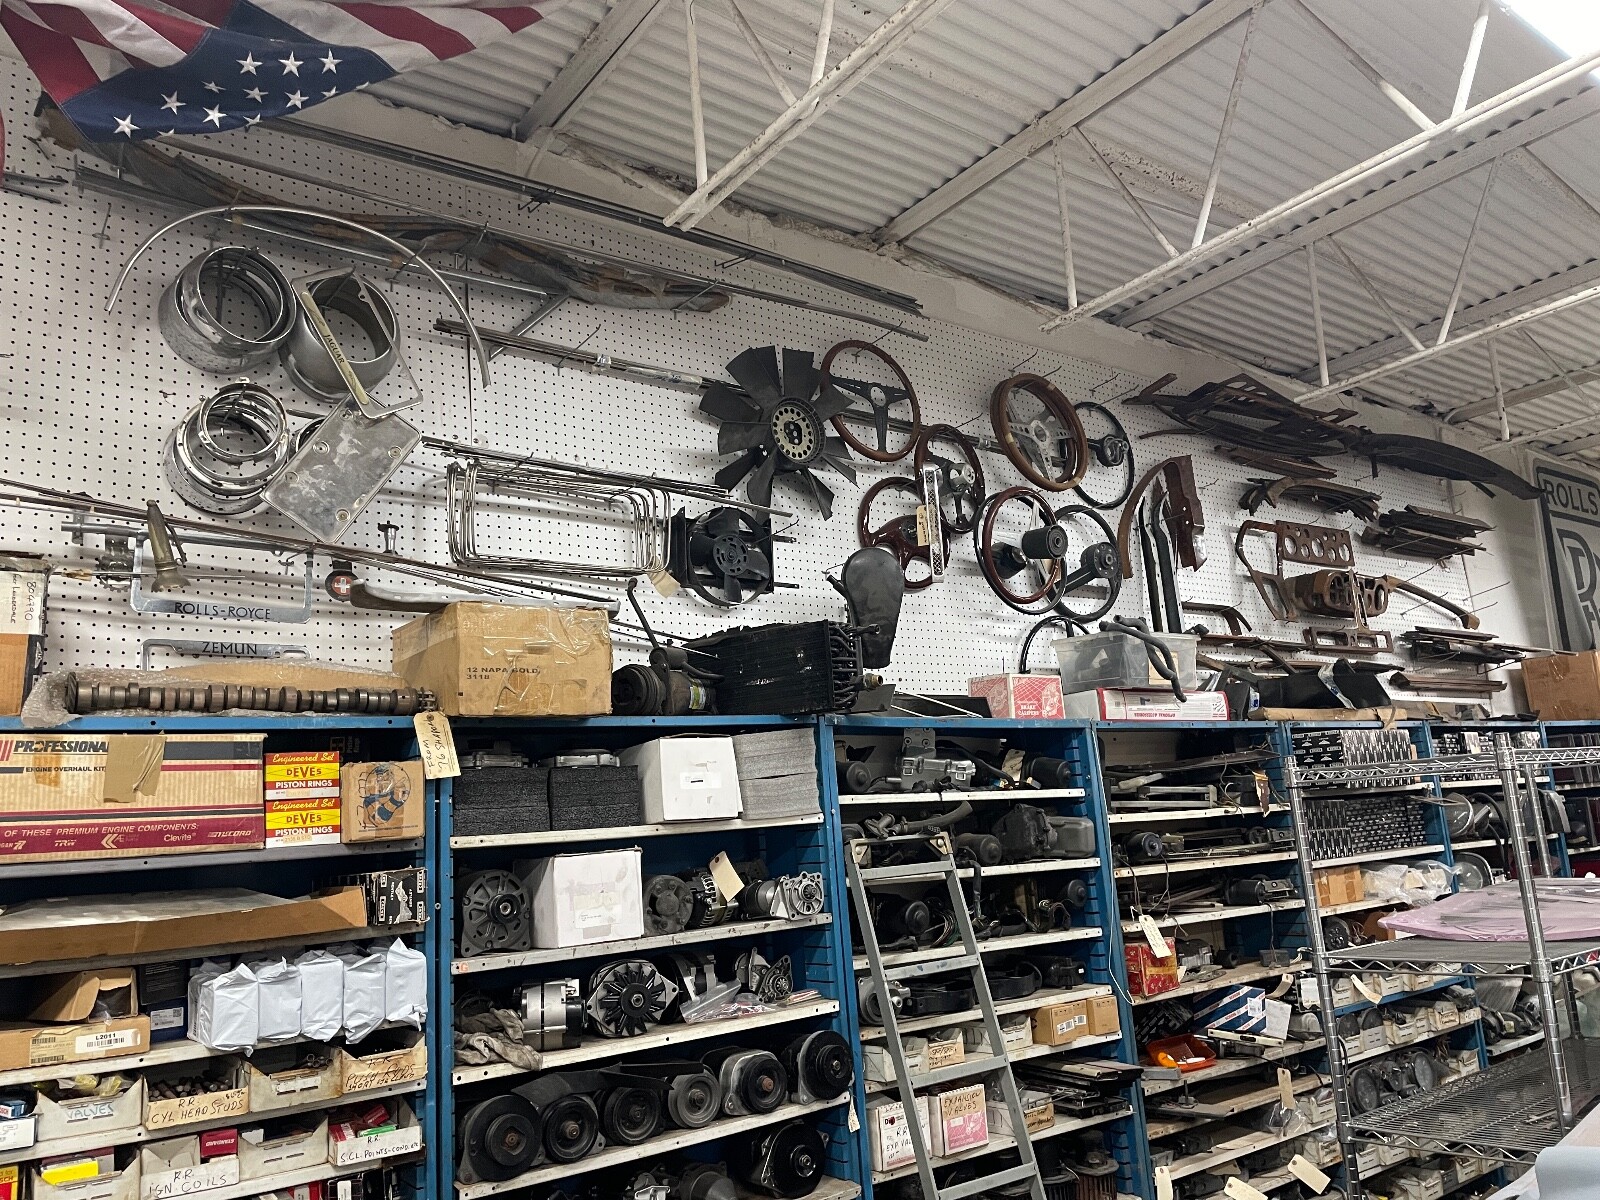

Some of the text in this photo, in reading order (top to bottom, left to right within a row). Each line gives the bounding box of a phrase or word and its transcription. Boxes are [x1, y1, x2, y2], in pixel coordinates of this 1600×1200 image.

[323, 334, 345, 364] JAGUAR
[1543, 479, 1600, 516] ROLLS
[174, 602, 271, 620] ROLLS-ROYCE
[202, 642, 258, 655] ZEMUN
[14, 740, 110, 752] PROFESSIONA
[272, 752, 335, 764] Engineered Set
[272, 799, 335, 811] Engineered Set
[21, 828, 52, 836] THESE
[56, 827, 98, 836] PREMIUM
[102, 826, 136, 834] ENGINE
[138, 822, 200, 832] COMPONENTS:
[276, 826, 332, 836] PISTON RINGS
[96, 1033, 116, 1041] L2011
[66, 1102, 115, 1120] VALVES
[152, 1100, 244, 1124] CYL HEAD STUDS
[182, 1174, 226, 1192] COILS
